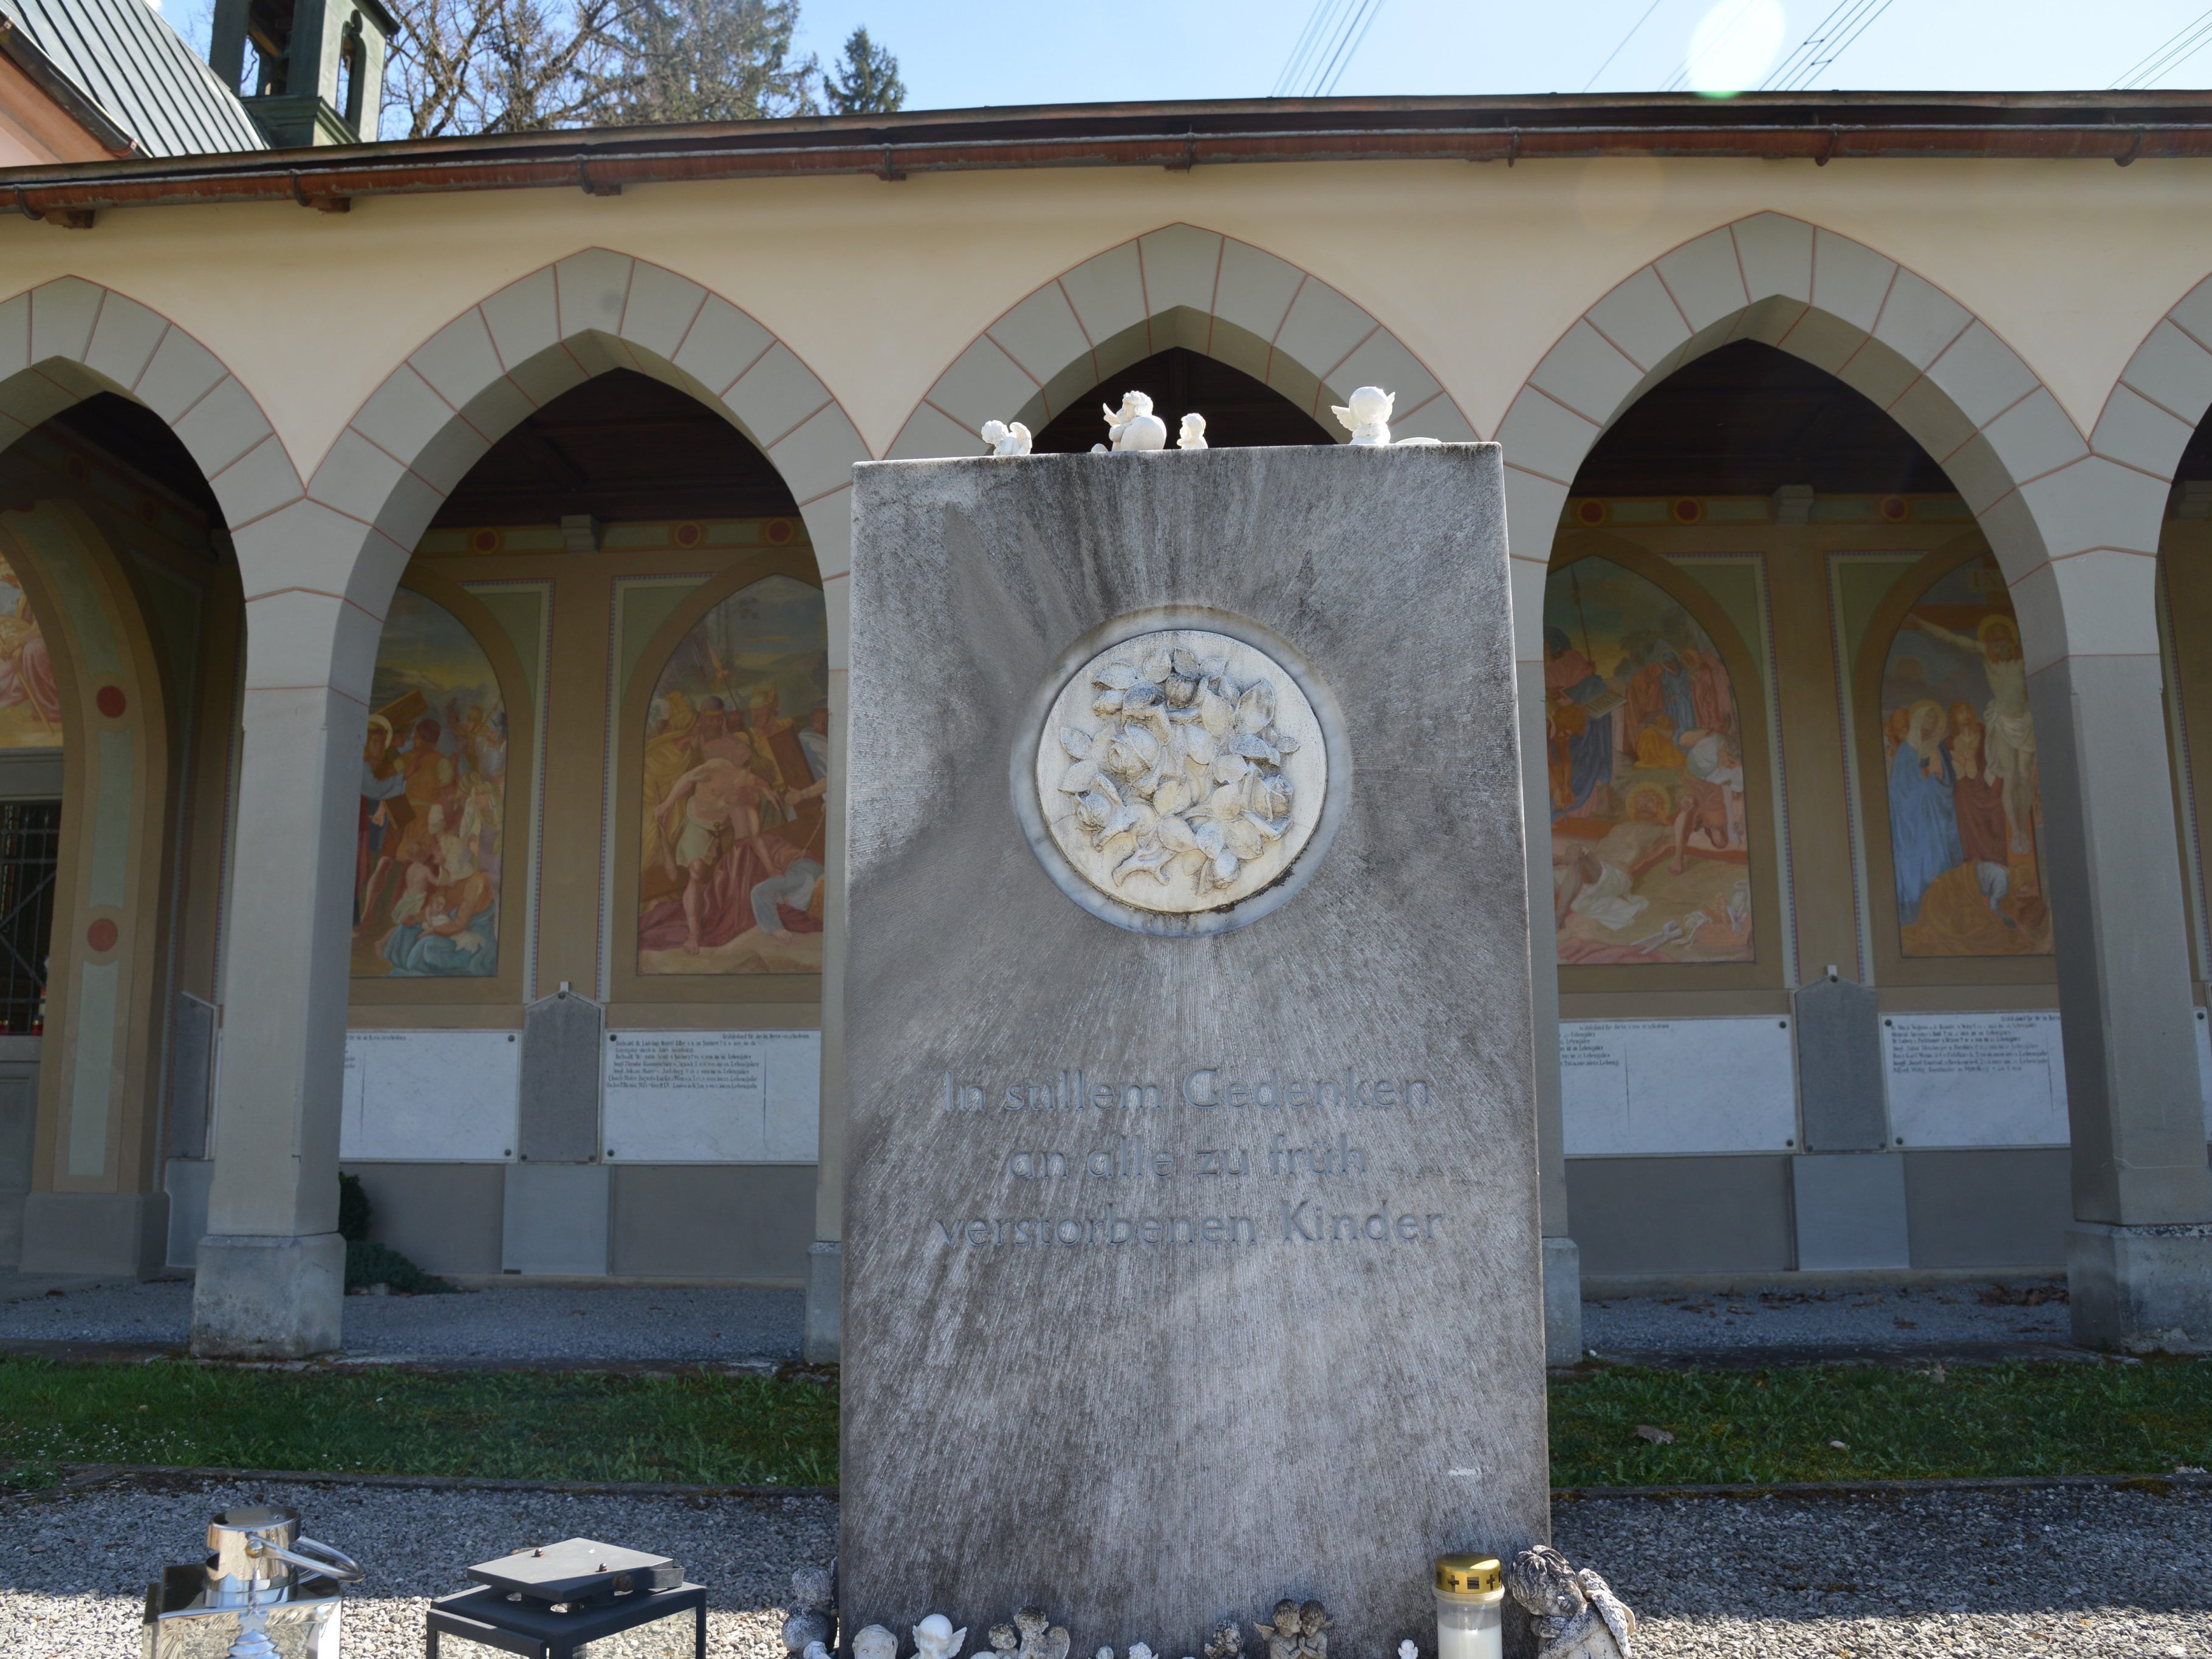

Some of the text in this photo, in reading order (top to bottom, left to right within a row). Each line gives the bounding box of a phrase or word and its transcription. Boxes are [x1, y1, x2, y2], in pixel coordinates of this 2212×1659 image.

[945, 1066, 1431, 1112] In stillem Gedenken
[1009, 1132, 1368, 1178] an alle zu früh
[934, 1199, 1442, 1247] verstorbenen Kinder
